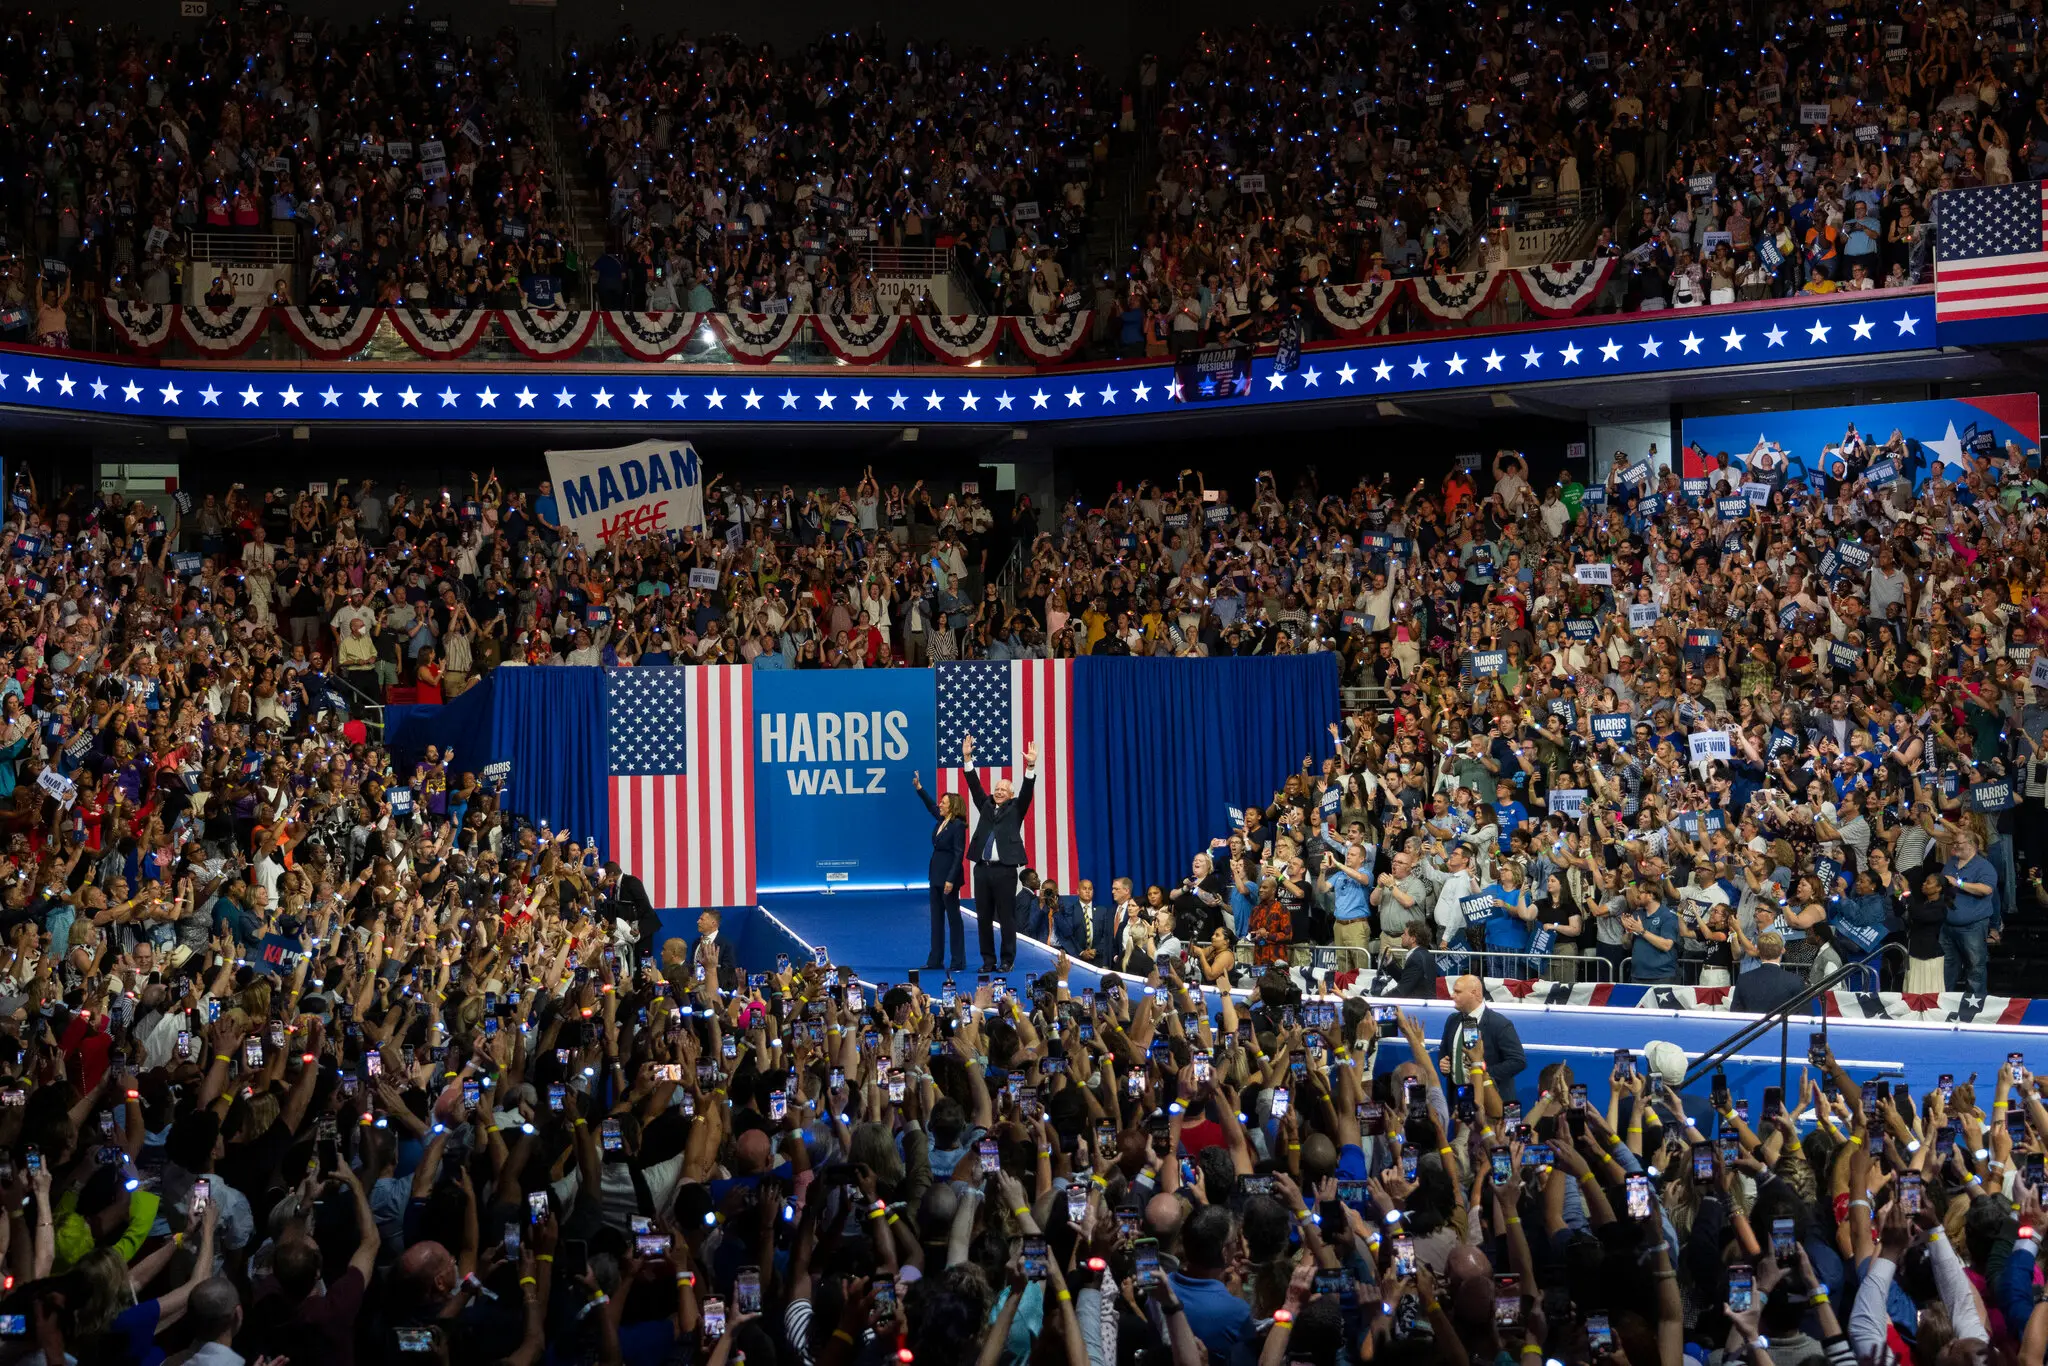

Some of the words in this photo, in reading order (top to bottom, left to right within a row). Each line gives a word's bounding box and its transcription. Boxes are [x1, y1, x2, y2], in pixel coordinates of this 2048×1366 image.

[185, 5, 204, 13] 210
[1993, 18, 2003, 26] WE
[2004, 14, 2016, 24] WIN
[1826, 24, 1847, 33] HARRIS
[1886, 48, 1907, 57] HARRIS
[1568, 91, 1588, 108] HARRIS
[1855, 126, 1878, 136] HARRIS
[1782, 143, 1795, 151] HAR
[1689, 176, 1712, 186] HARRIS
[1520, 237, 1537, 249] 211
[1763, 239, 1781, 265] HARRIS
[232, 273, 253, 285] 210
[880, 284, 898, 295] 210
[1198, 349, 1236, 364] MADAM
[1197, 361, 1233, 372] PRESIDENT
[1570, 445, 1582, 456] EXIT
[1623, 465, 1647, 482] HARRIS
[1867, 471, 1878, 482] WE
[1878, 467, 1893, 478] WIN
[563, 448, 698, 518] MADAM
[1684, 481, 1708, 490] HARRIS
[1754, 491, 1765, 499] WIN
[1720, 500, 1746, 510] HARRIS
[1166, 514, 1187, 523] HARRIS
[1206, 507, 1229, 519] HARRIS
[598, 500, 669, 544] VICE
[1364, 535, 1391, 547] KAMALA
[1840, 544, 1870, 562] HARRIS
[188, 560, 200, 568] WIN
[1819, 550, 1836, 574] HARRIS
[1842, 555, 1862, 566] WALZ
[1826, 560, 1838, 576] WALZ
[703, 576, 715, 584] WIN
[1581, 570, 1593, 578] WE
[1594, 570, 1608, 579] WIN
[2000, 603, 2019, 612] RRIS
[1633, 612, 1644, 621] WE
[1645, 611, 1657, 620] WIN
[1567, 621, 1594, 631] HARRIS
[163, 631, 173, 641] WE
[1169, 626, 1183, 646] HARRI
[1689, 635, 1718, 646] KAMALA
[1832, 644, 1858, 660] HARRIS
[2009, 647, 2030, 657] HARR
[1475, 654, 1503, 666] HARRIS
[1835, 658, 1851, 666] WALZ
[1480, 664, 1499, 672] WALZ
[2036, 666, 2045, 678] WE
[1553, 702, 1564, 717] RIS
[1594, 718, 1626, 731] HARRIS
[761, 710, 908, 762] HARRIS
[1600, 730, 1622, 738] WALZ
[73, 743, 93, 758] WALZ
[1695, 744, 1708, 753] WE
[484, 761, 510, 776] HARRIS
[44, 775, 61, 789] WIN
[787, 768, 886, 795] WALZ
[391, 789, 410, 803] HAR
[1322, 789, 1339, 806] HARRIS
[1976, 784, 2009, 801] HARRIS
[1325, 802, 1337, 812] WALZ
[1554, 800, 1565, 810] WE
[1982, 797, 2005, 808] WALZ
[1229, 807, 1244, 819] HAR
[1706, 817, 1721, 828] WE
[1462, 895, 1493, 914] HARRIS
[1468, 908, 1492, 922] WALZ
[1537, 930, 1550, 950] WIN
[1861, 926, 1879, 942] WE
